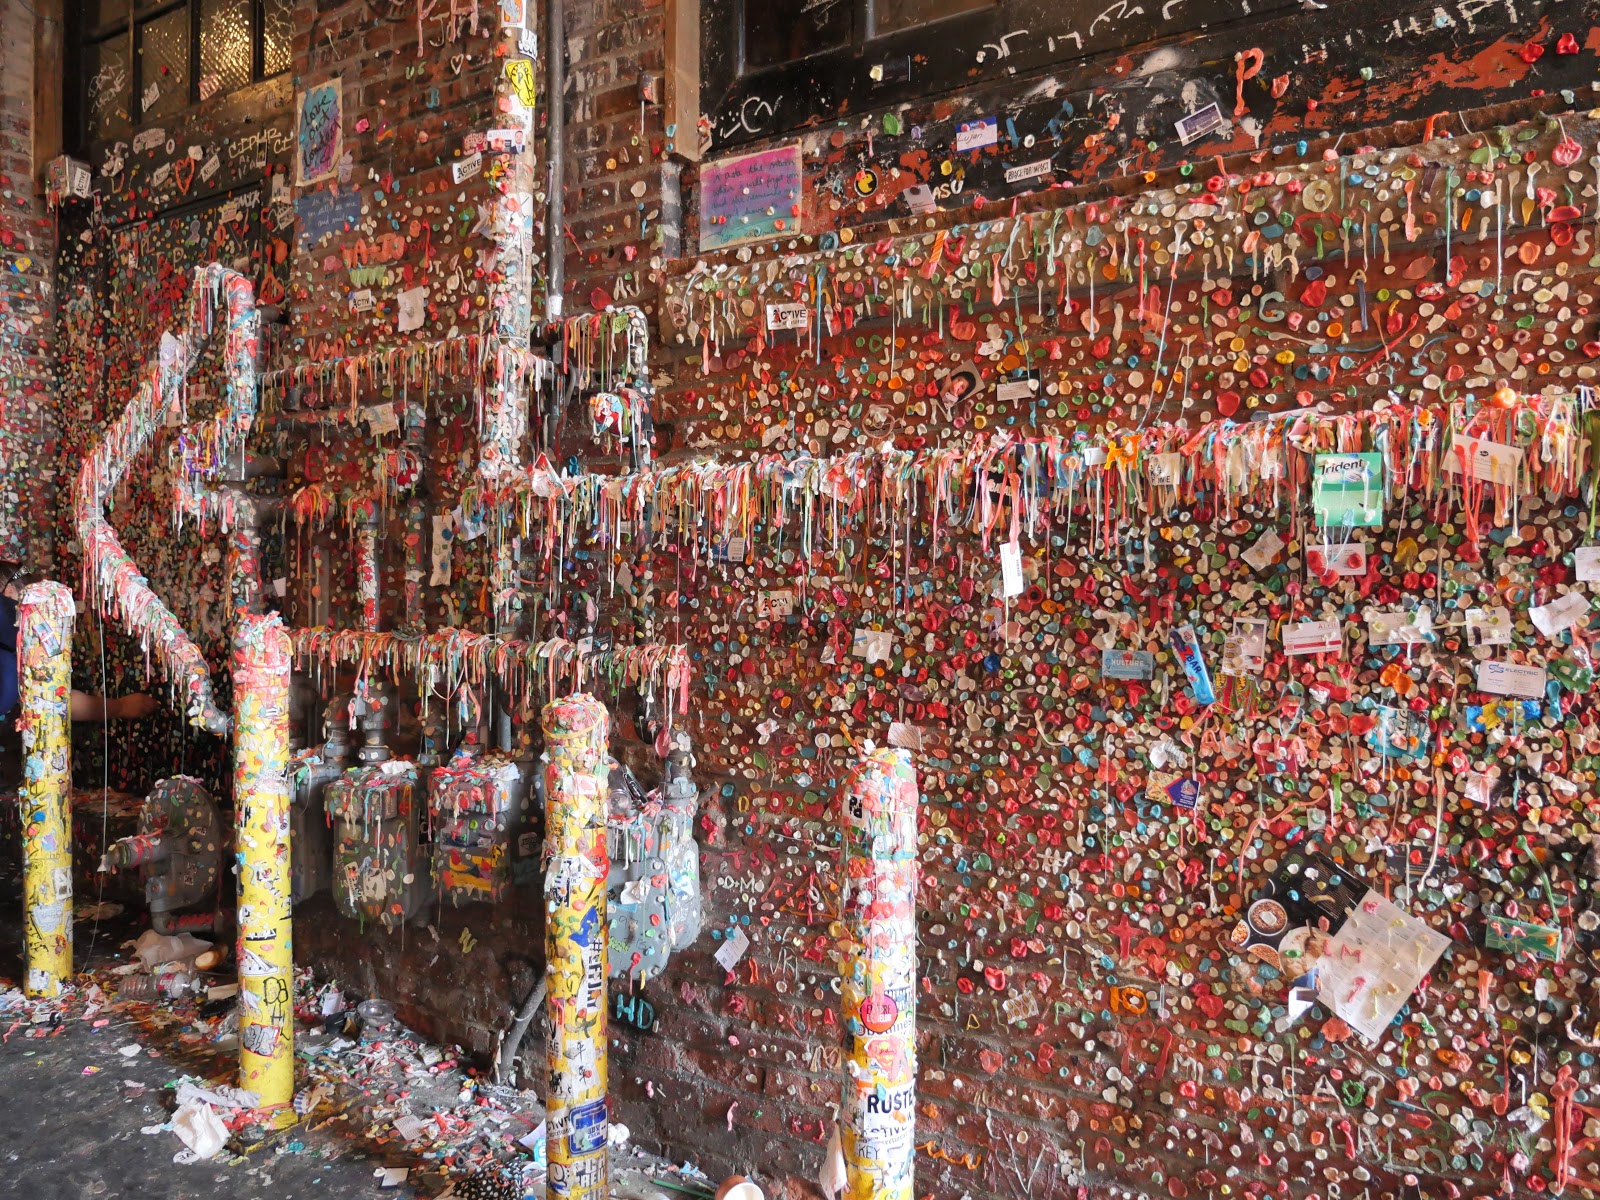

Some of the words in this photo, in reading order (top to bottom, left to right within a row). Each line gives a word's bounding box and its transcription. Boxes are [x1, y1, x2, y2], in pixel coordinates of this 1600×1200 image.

[457, 160, 482, 178] ACTIVE
[1319, 459, 1364, 476] Trident
[1505, 668, 1538, 676] ELECTRIC
[616, 994, 655, 1030] HD
